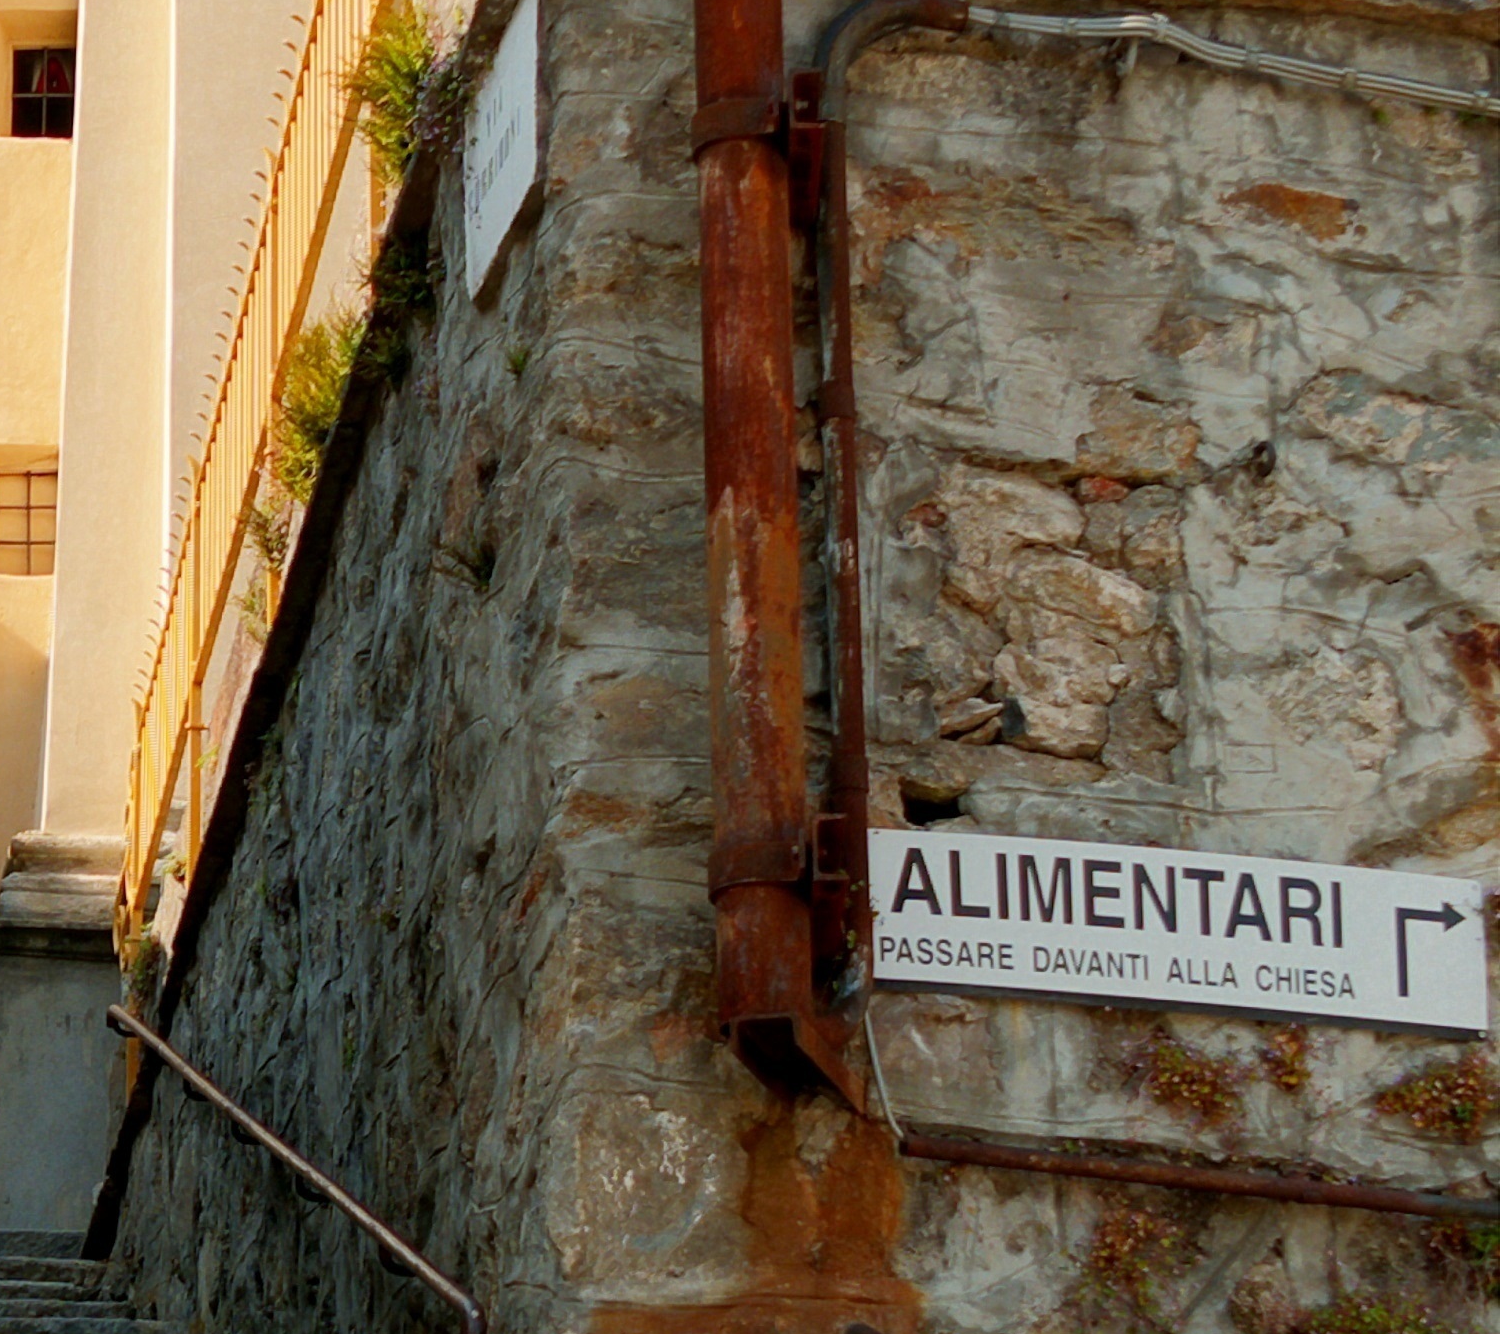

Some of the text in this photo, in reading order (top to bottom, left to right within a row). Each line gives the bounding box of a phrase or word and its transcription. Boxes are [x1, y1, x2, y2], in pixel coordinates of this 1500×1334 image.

[890, 847, 1343, 948] ALIMENTARI
[879, 936, 1356, 1000] PASSARE DAVANTI ALLA CHIESA
